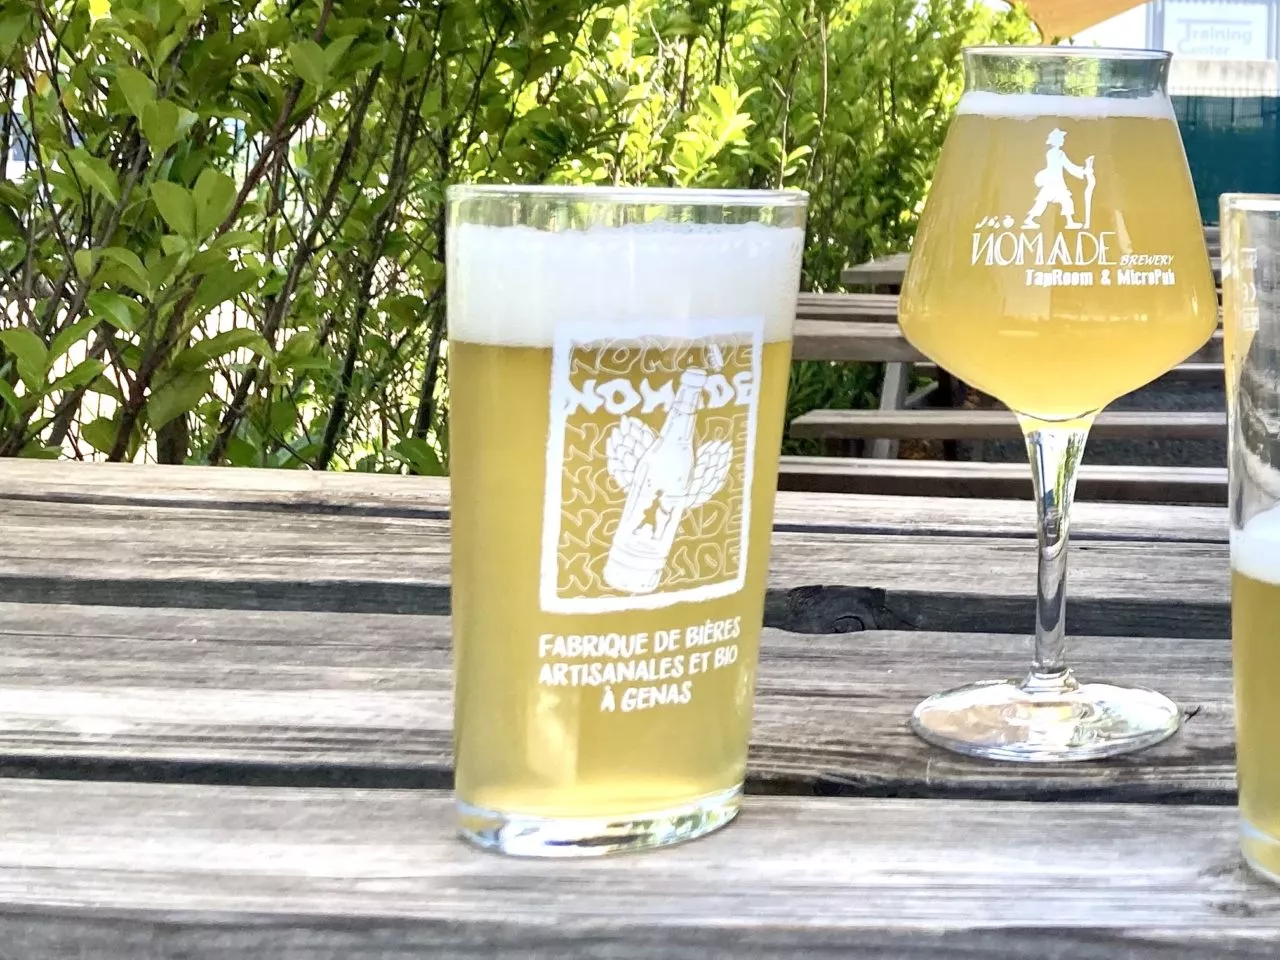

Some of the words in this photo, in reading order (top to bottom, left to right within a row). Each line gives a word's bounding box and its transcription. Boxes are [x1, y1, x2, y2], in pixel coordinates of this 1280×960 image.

[1177, 18, 1252, 44] Training
[971, 231, 1117, 266] NOMADE
[1119, 254, 1174, 266] BREWERY
[1025, 269, 1093, 288] TapRoom
[1100, 269, 1111, 286] &
[1118, 269, 1176, 286] MicroPub
[565, 371, 753, 414] NOMDE
[538, 632, 649, 659] FABRIQUE
[653, 628, 682, 654] DE
[685, 616, 742, 648] BIÈRES
[538, 654, 685, 687] ARTISANALES
[688, 651, 712, 675] ET
[714, 644, 738, 670] BIO
[600, 684, 616, 713] À
[620, 680, 693, 712] GENAS
